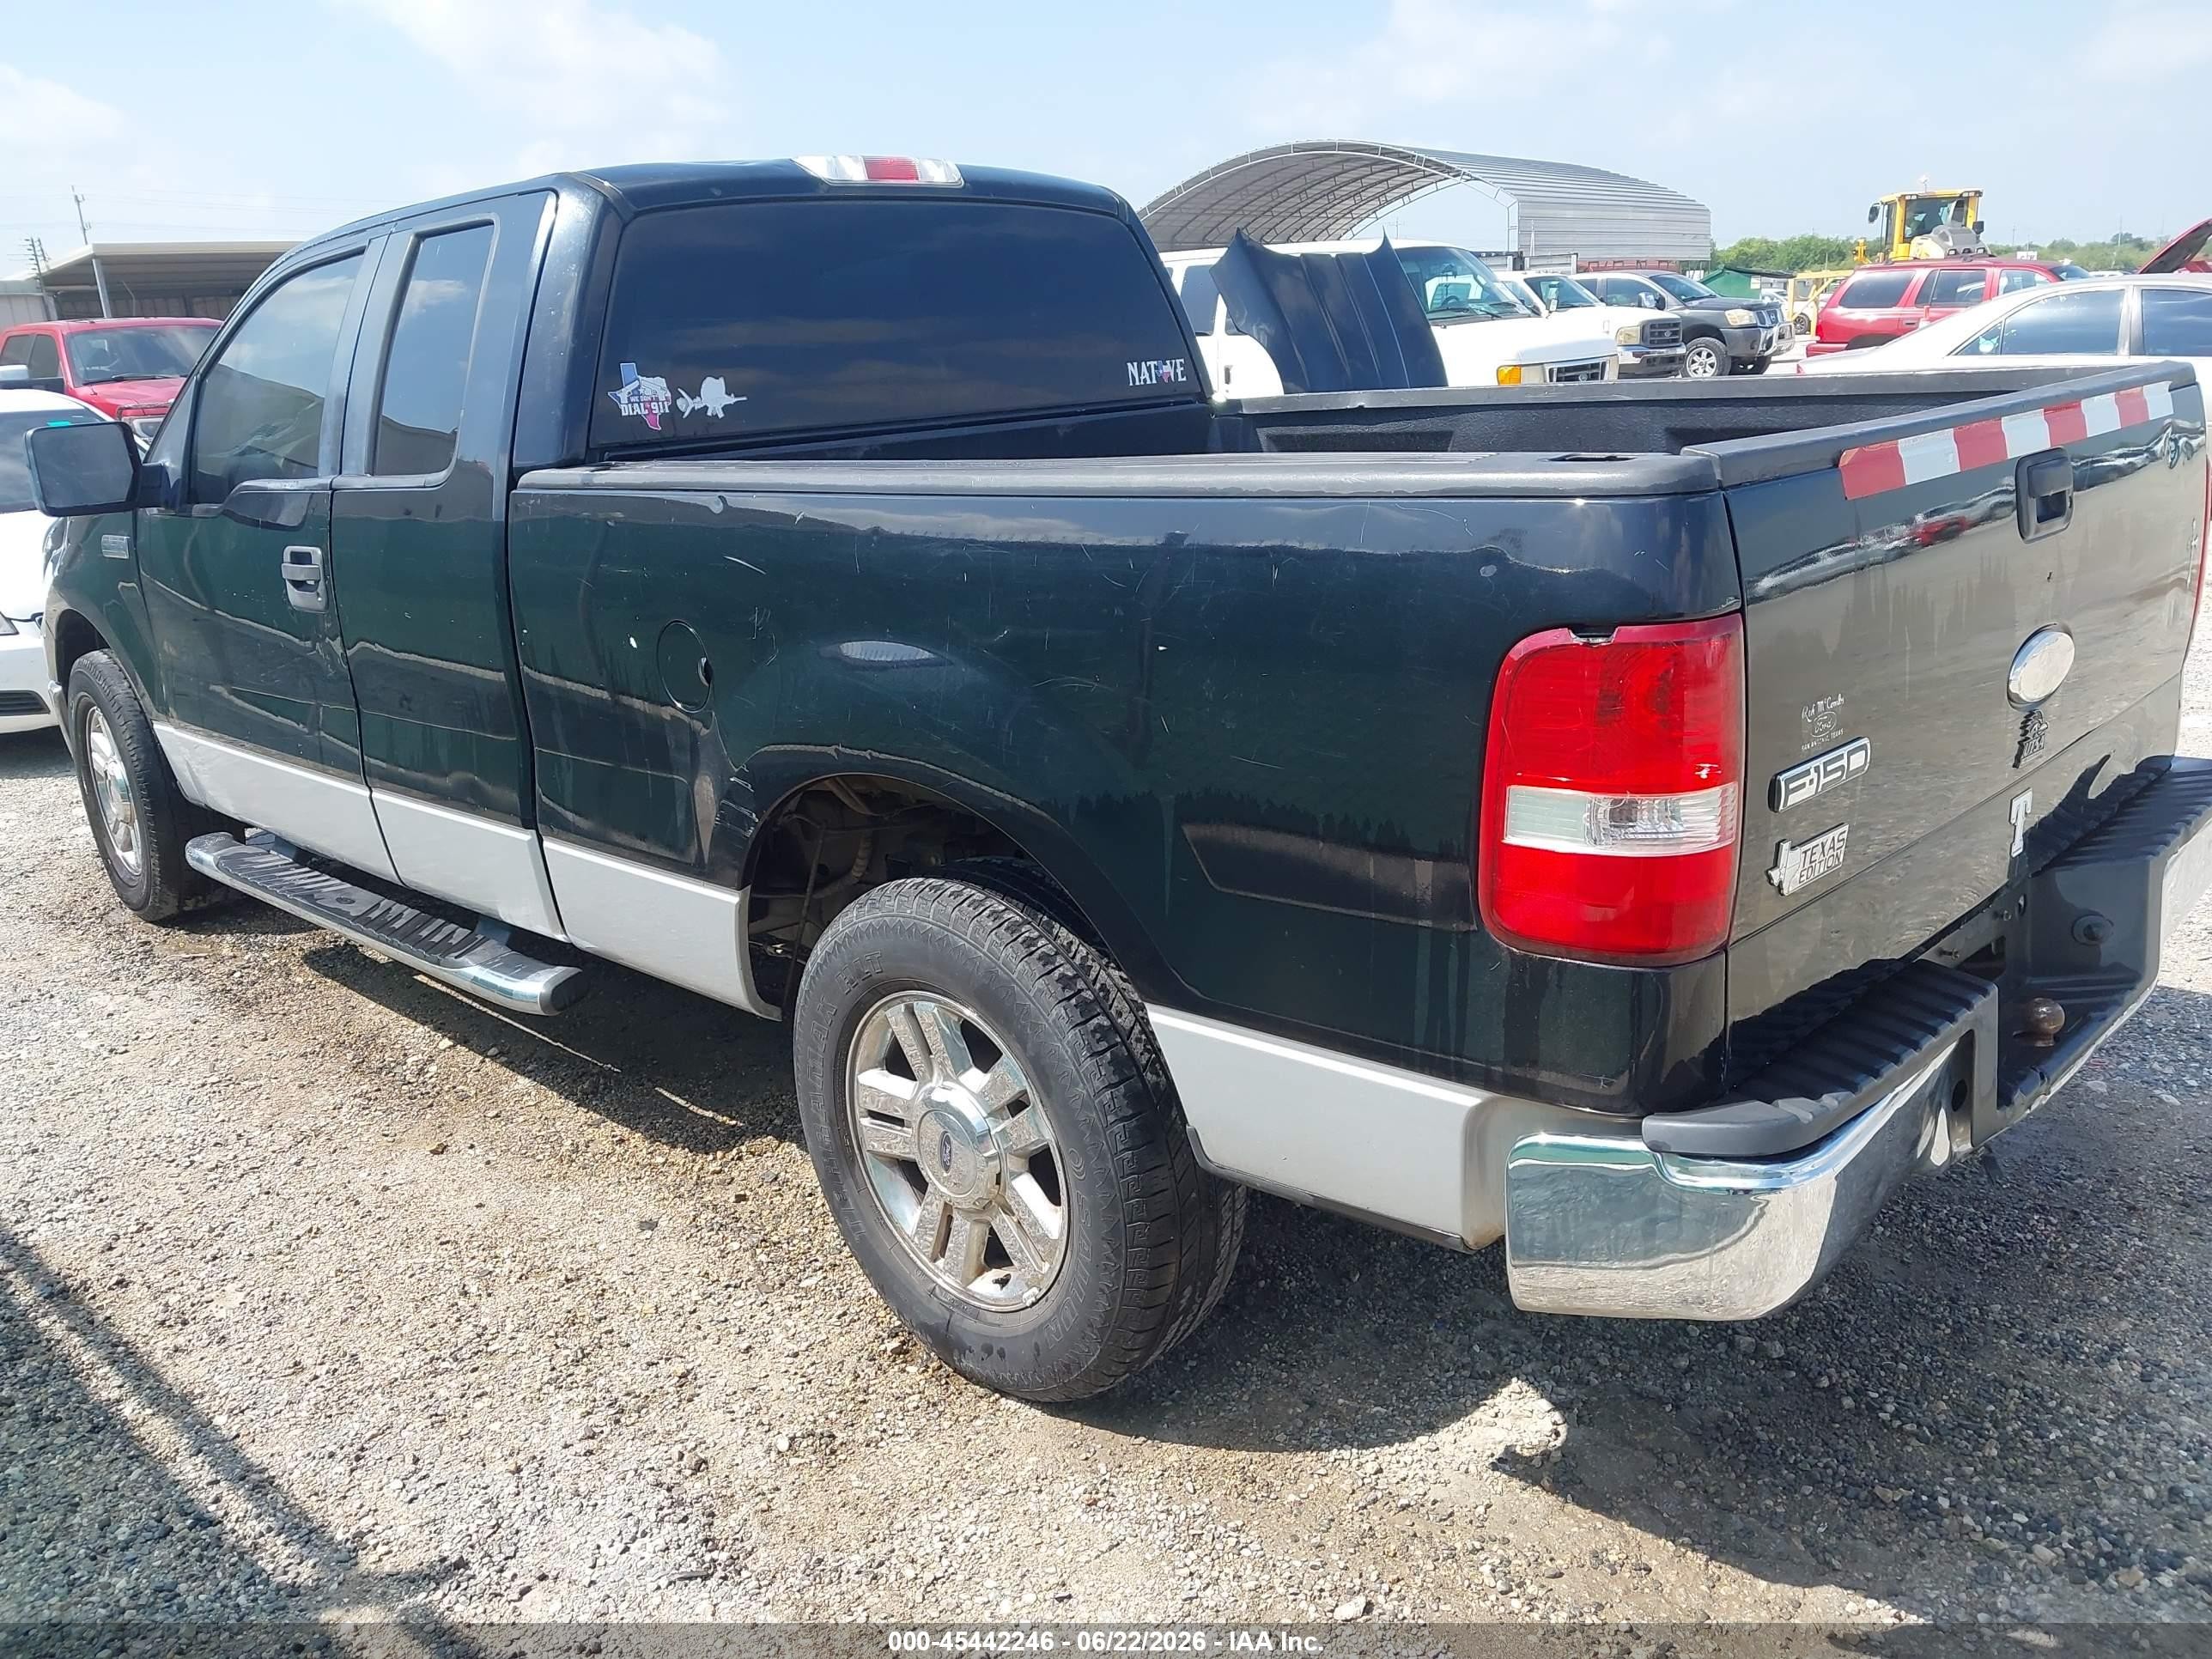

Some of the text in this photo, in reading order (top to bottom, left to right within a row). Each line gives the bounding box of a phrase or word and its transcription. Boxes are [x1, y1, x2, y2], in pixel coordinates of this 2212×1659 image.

[621, 401, 670, 416] DIAL 911
[1802, 829, 1847, 867] TEXAS
[1798, 851, 1844, 884] EDITION
